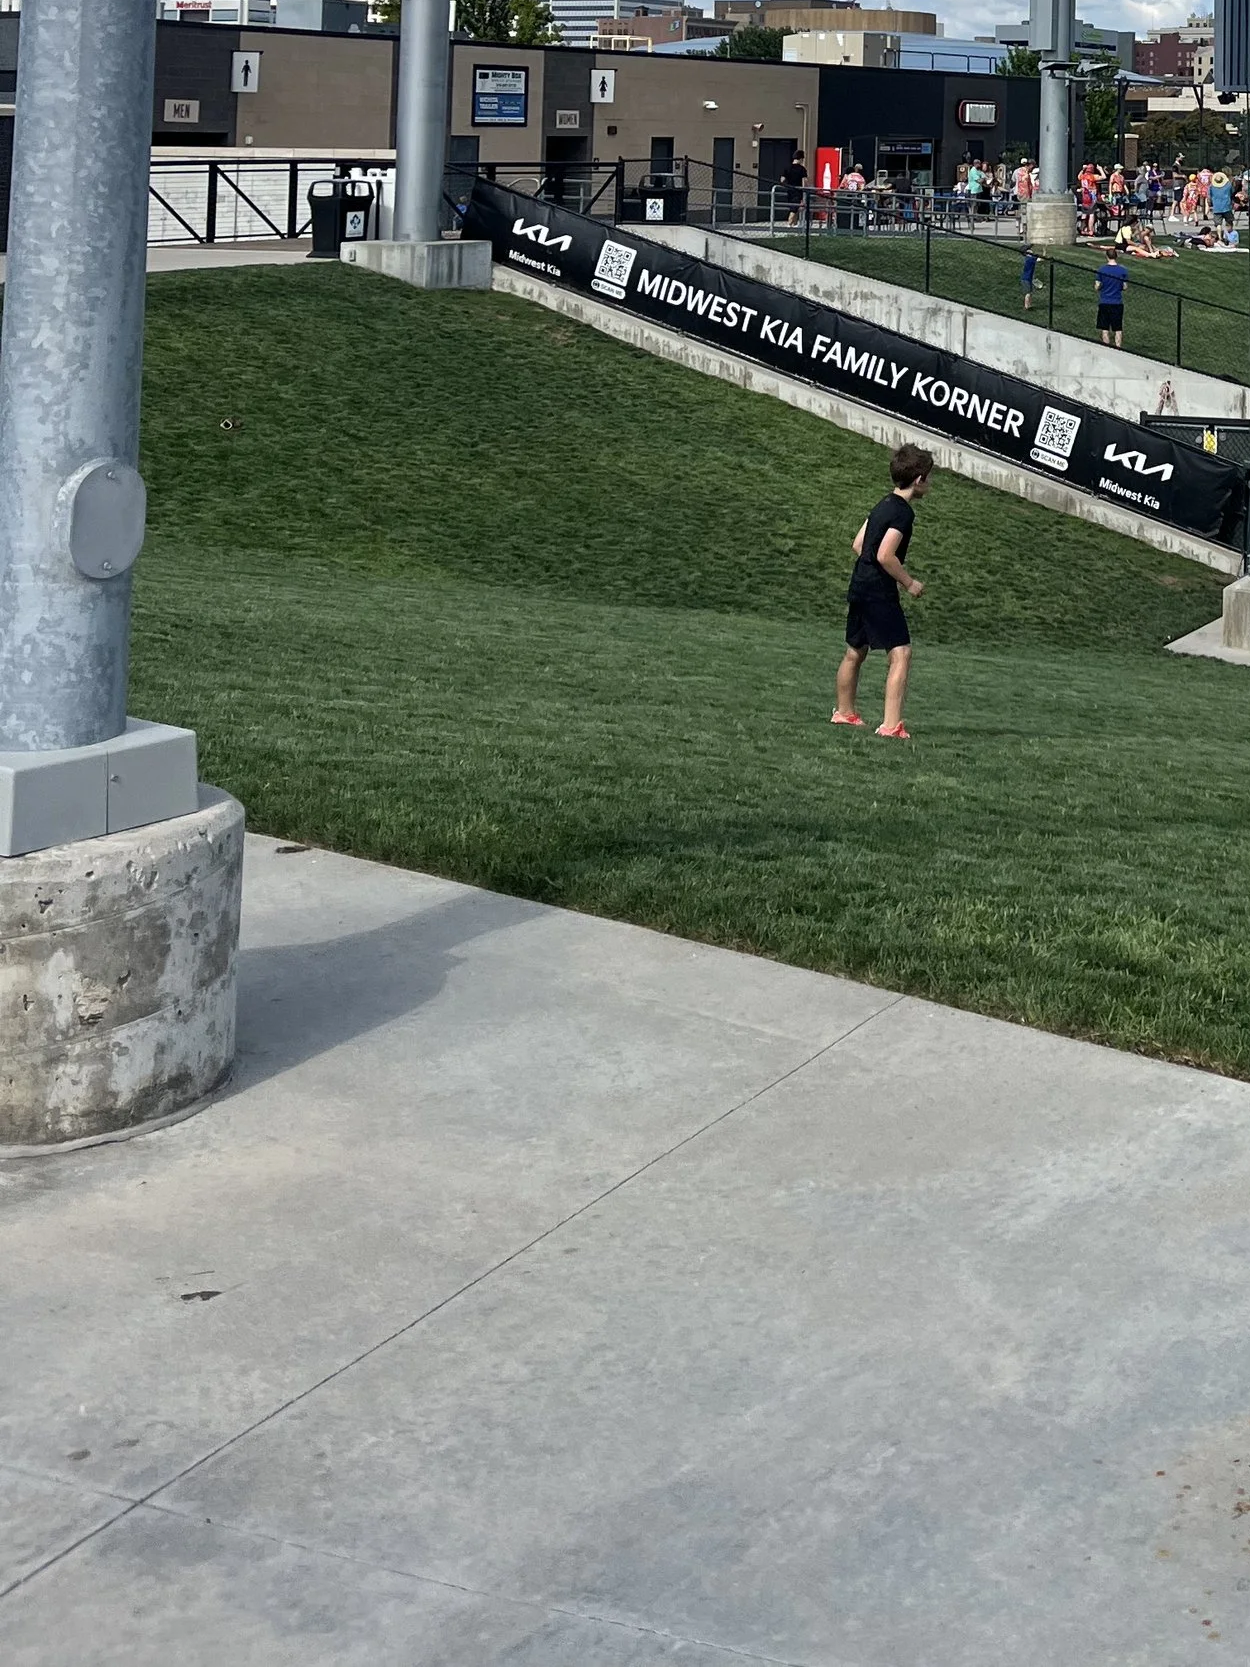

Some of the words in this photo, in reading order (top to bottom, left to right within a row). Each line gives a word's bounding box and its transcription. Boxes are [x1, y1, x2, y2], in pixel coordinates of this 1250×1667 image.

[176, 1, 212, 9] Meritrust
[173, 103, 191, 119] MEN
[512, 218, 573, 252] KIA
[509, 249, 546, 271] Midwest
[547, 264, 561, 277] Kia
[636, 268, 758, 333] MIDWEST
[759, 314, 804, 355] KIA
[810, 334, 910, 390] FAMILY
[911, 371, 1026, 438] KORNER
[1040, 453, 1057, 464] SCAN
[1104, 443, 1174, 482] KIA
[1099, 477, 1143, 503] Midwest
[1143, 494, 1160, 510] Kia
